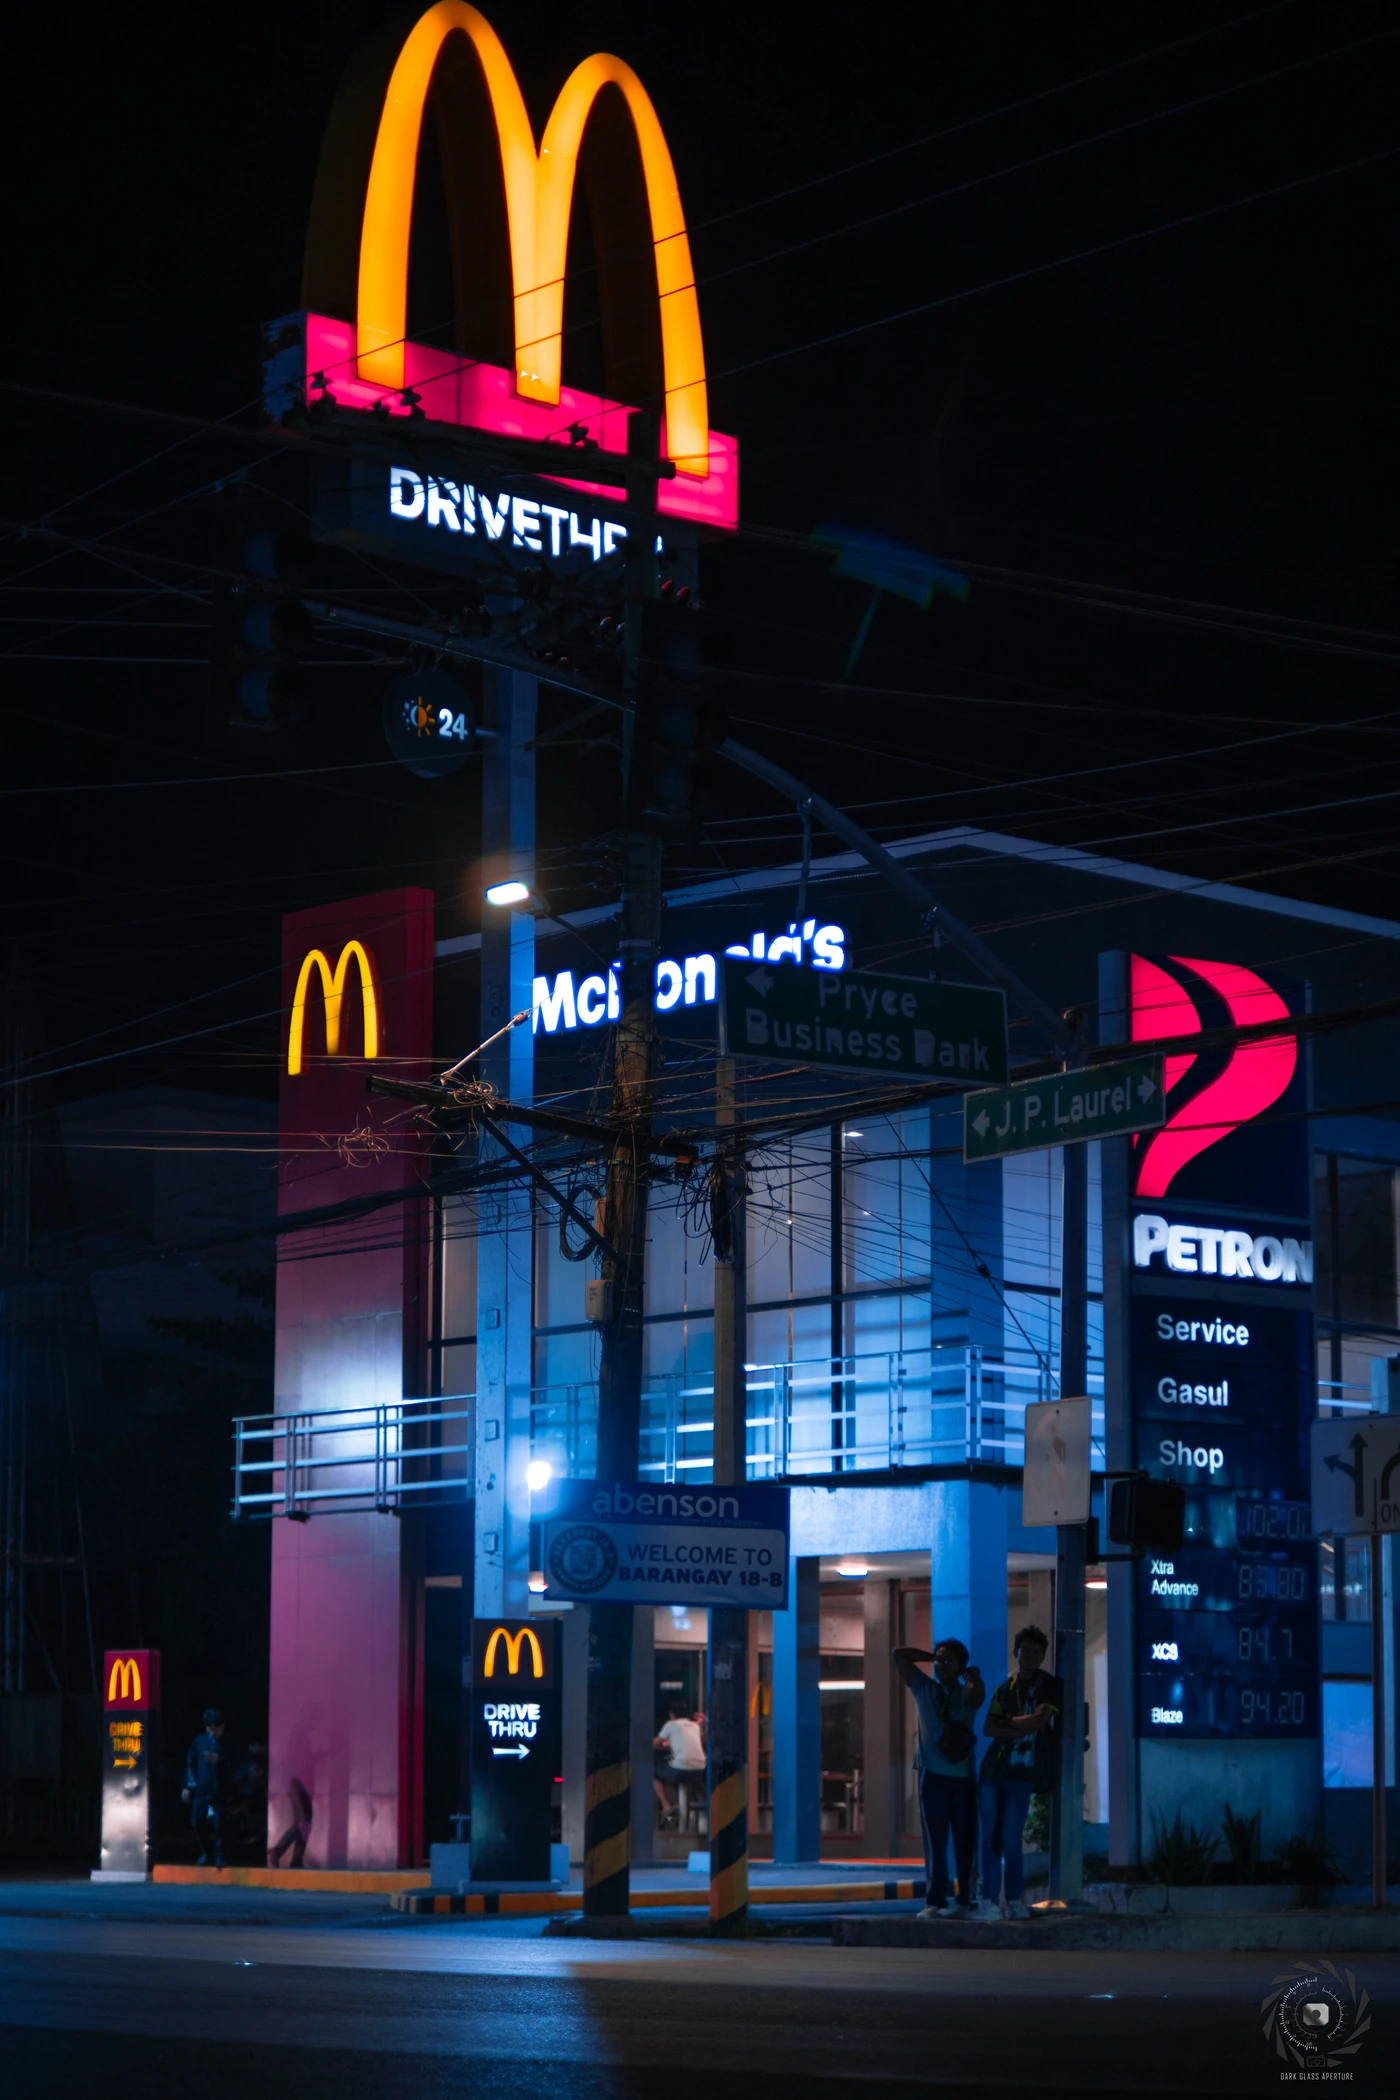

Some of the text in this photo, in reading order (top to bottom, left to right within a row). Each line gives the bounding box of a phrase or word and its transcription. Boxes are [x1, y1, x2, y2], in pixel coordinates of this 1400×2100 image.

[438, 708, 469, 741] 24
[817, 973, 918, 1020] Pryce
[745, 1007, 902, 1061] Business
[1054, 1076, 1132, 1126] Laurel
[1133, 1214, 1314, 1284] PETRON
[1157, 1313, 1250, 1346] Service
[1157, 1377, 1229, 1407] Gasul
[1159, 1439, 1225, 1475] Shop
[592, 1483, 740, 1519] abenson
[626, 1543, 773, 1567] WELCOME TO
[1150, 1558, 1175, 1575] Xtra
[617, 1566, 734, 1586] BARANGAY
[738, 1571, 783, 1587] 18-B
[1150, 1578, 1200, 1597] Advance
[1151, 1643, 1180, 1662] XCS
[483, 1703, 542, 1721] DRIVE
[1150, 1706, 1184, 1725] Blaze
[1240, 1690, 1305, 1725] 94.20
[488, 1720, 538, 1738] THRU
